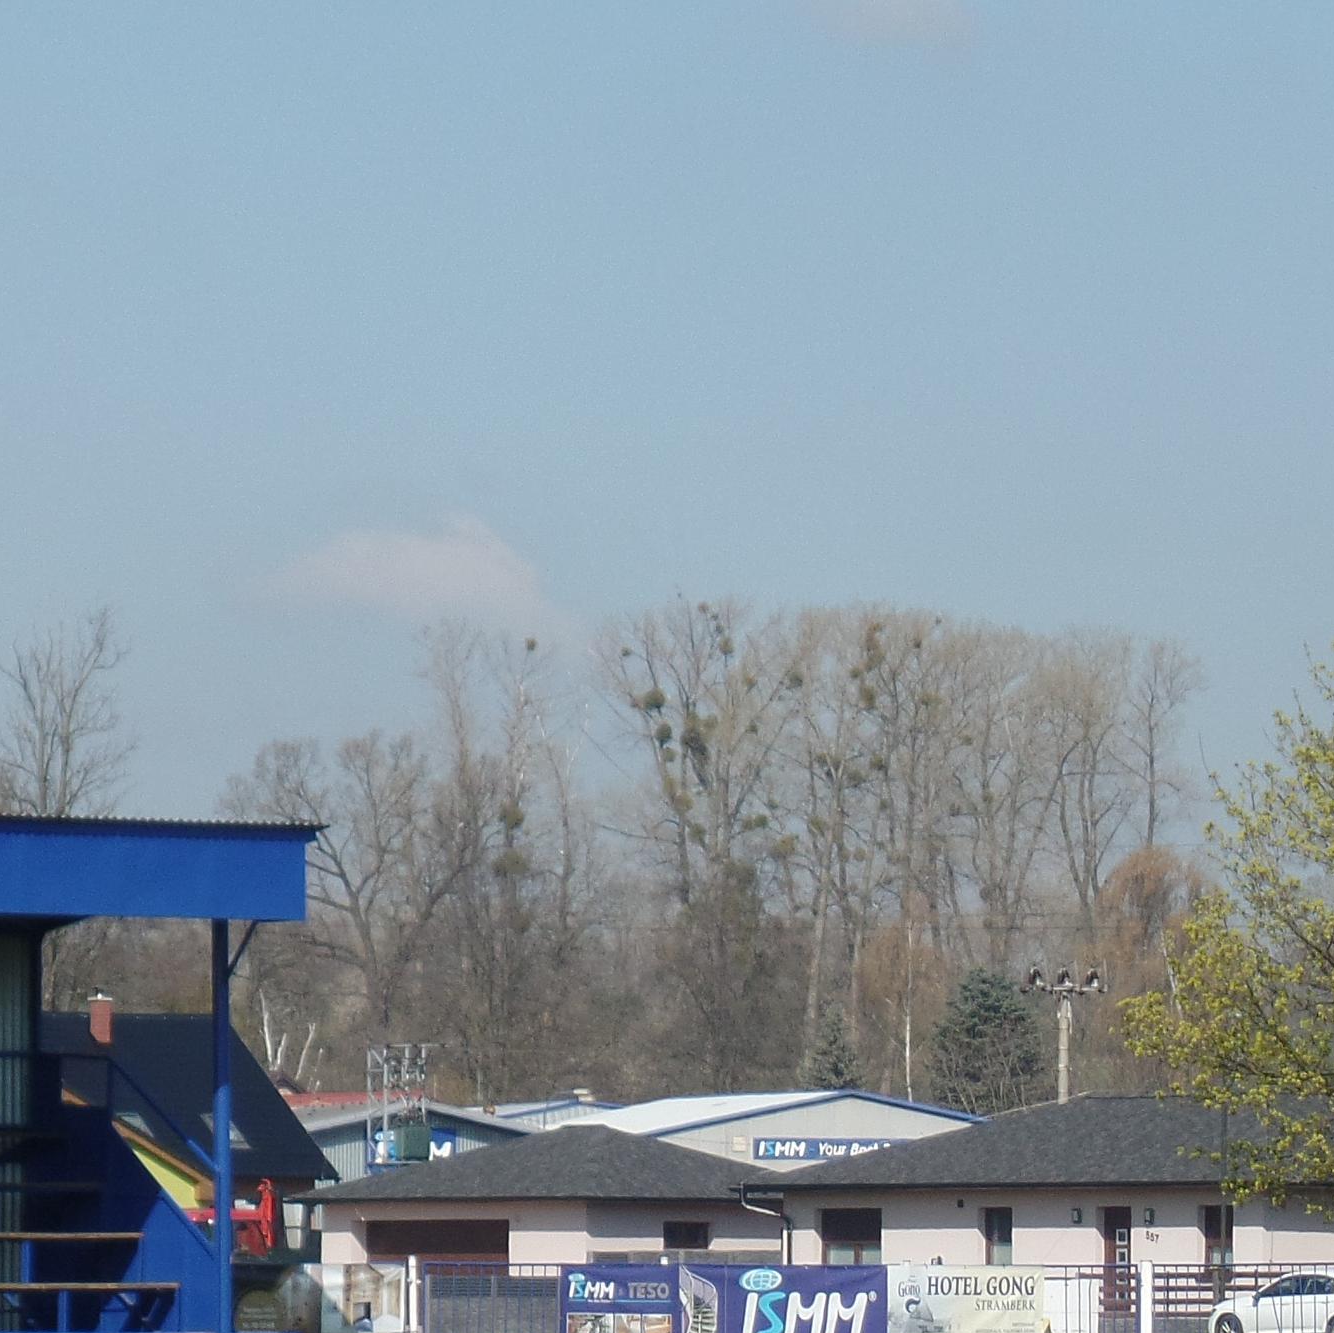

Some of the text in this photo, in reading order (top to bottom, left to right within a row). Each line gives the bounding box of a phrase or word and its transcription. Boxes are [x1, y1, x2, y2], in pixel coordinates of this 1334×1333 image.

[758, 1140, 806, 1157] ISMM
[818, 1142, 847, 1156] Your
[569, 1280, 615, 1299] ISMM
[628, 1282, 670, 1299] TESO
[927, 1276, 982, 1296] HOTEL
[986, 1276, 1035, 1296] GONG
